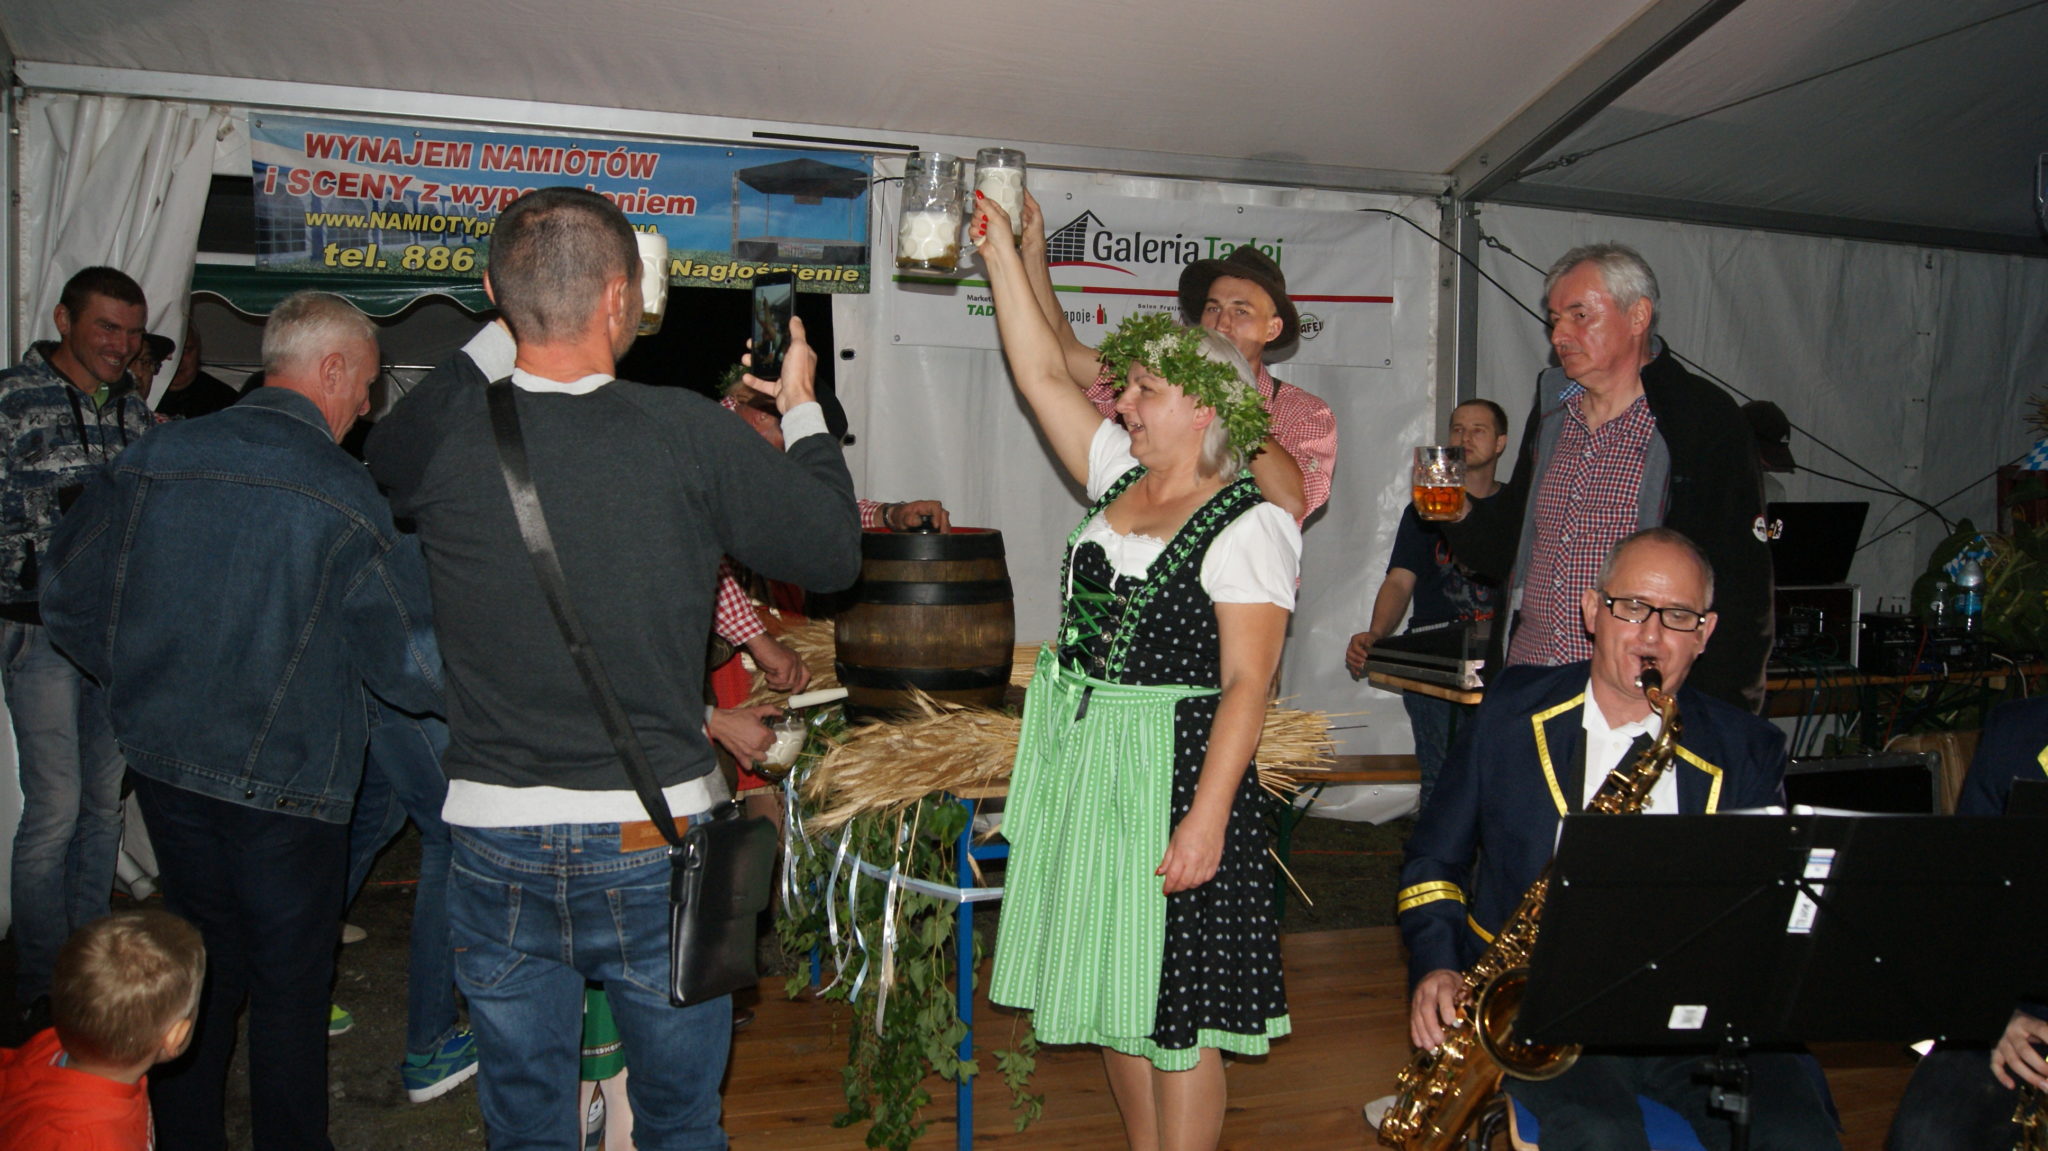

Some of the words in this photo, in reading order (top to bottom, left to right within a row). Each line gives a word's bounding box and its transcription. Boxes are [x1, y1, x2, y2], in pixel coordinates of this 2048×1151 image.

[305, 132, 472, 168] WYNAJEM
[481, 144, 659, 179] NAMIOTÓW
[264, 167, 278, 195] i
[286, 169, 413, 201] SCENY
[419, 184, 439, 203] z
[323, 242, 387, 268] tel.
[401, 245, 475, 272] 886
[1093, 230, 1199, 265] Galeria
[967, 304, 996, 316] TAD
[1063, 308, 1091, 324] apoje
